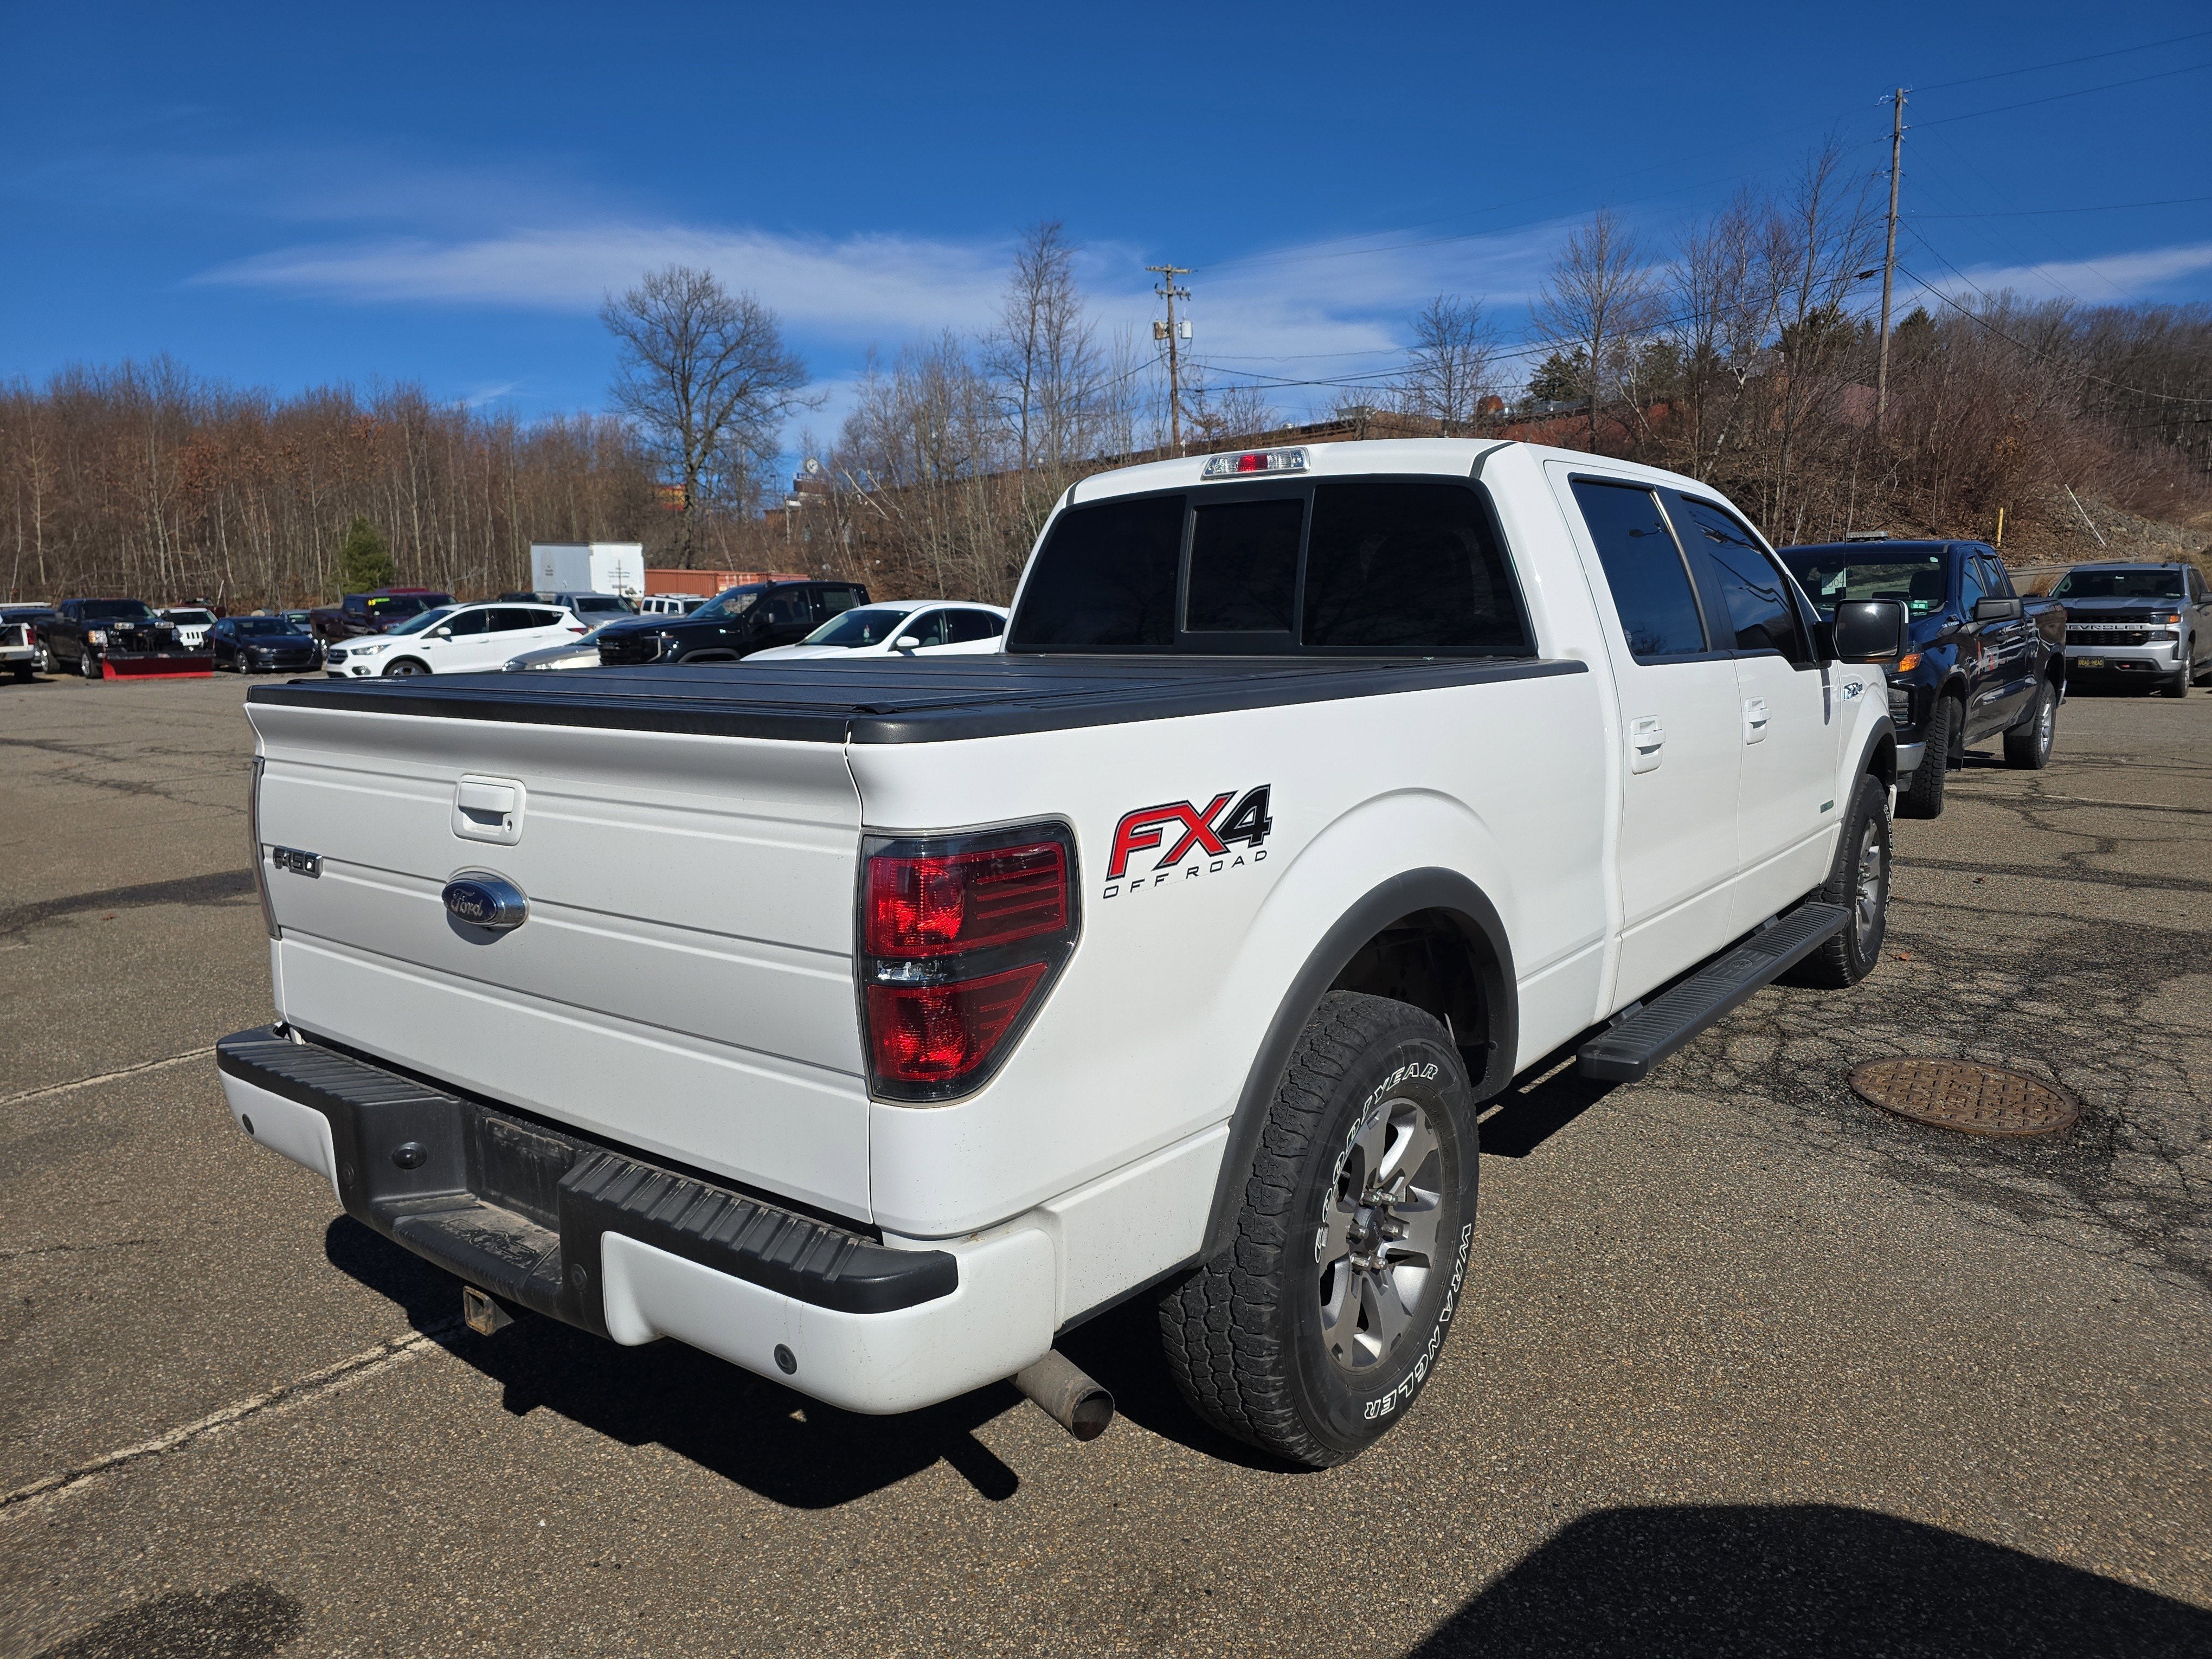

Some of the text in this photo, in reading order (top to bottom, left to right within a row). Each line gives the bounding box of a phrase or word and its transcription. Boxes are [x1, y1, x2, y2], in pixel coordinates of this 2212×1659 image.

[1105, 783, 1273, 882] FX4
[451, 888, 484, 917] Ford
[1103, 850, 1268, 899] OFF ROAD
[1364, 1223, 1472, 1419] WRANGLER
